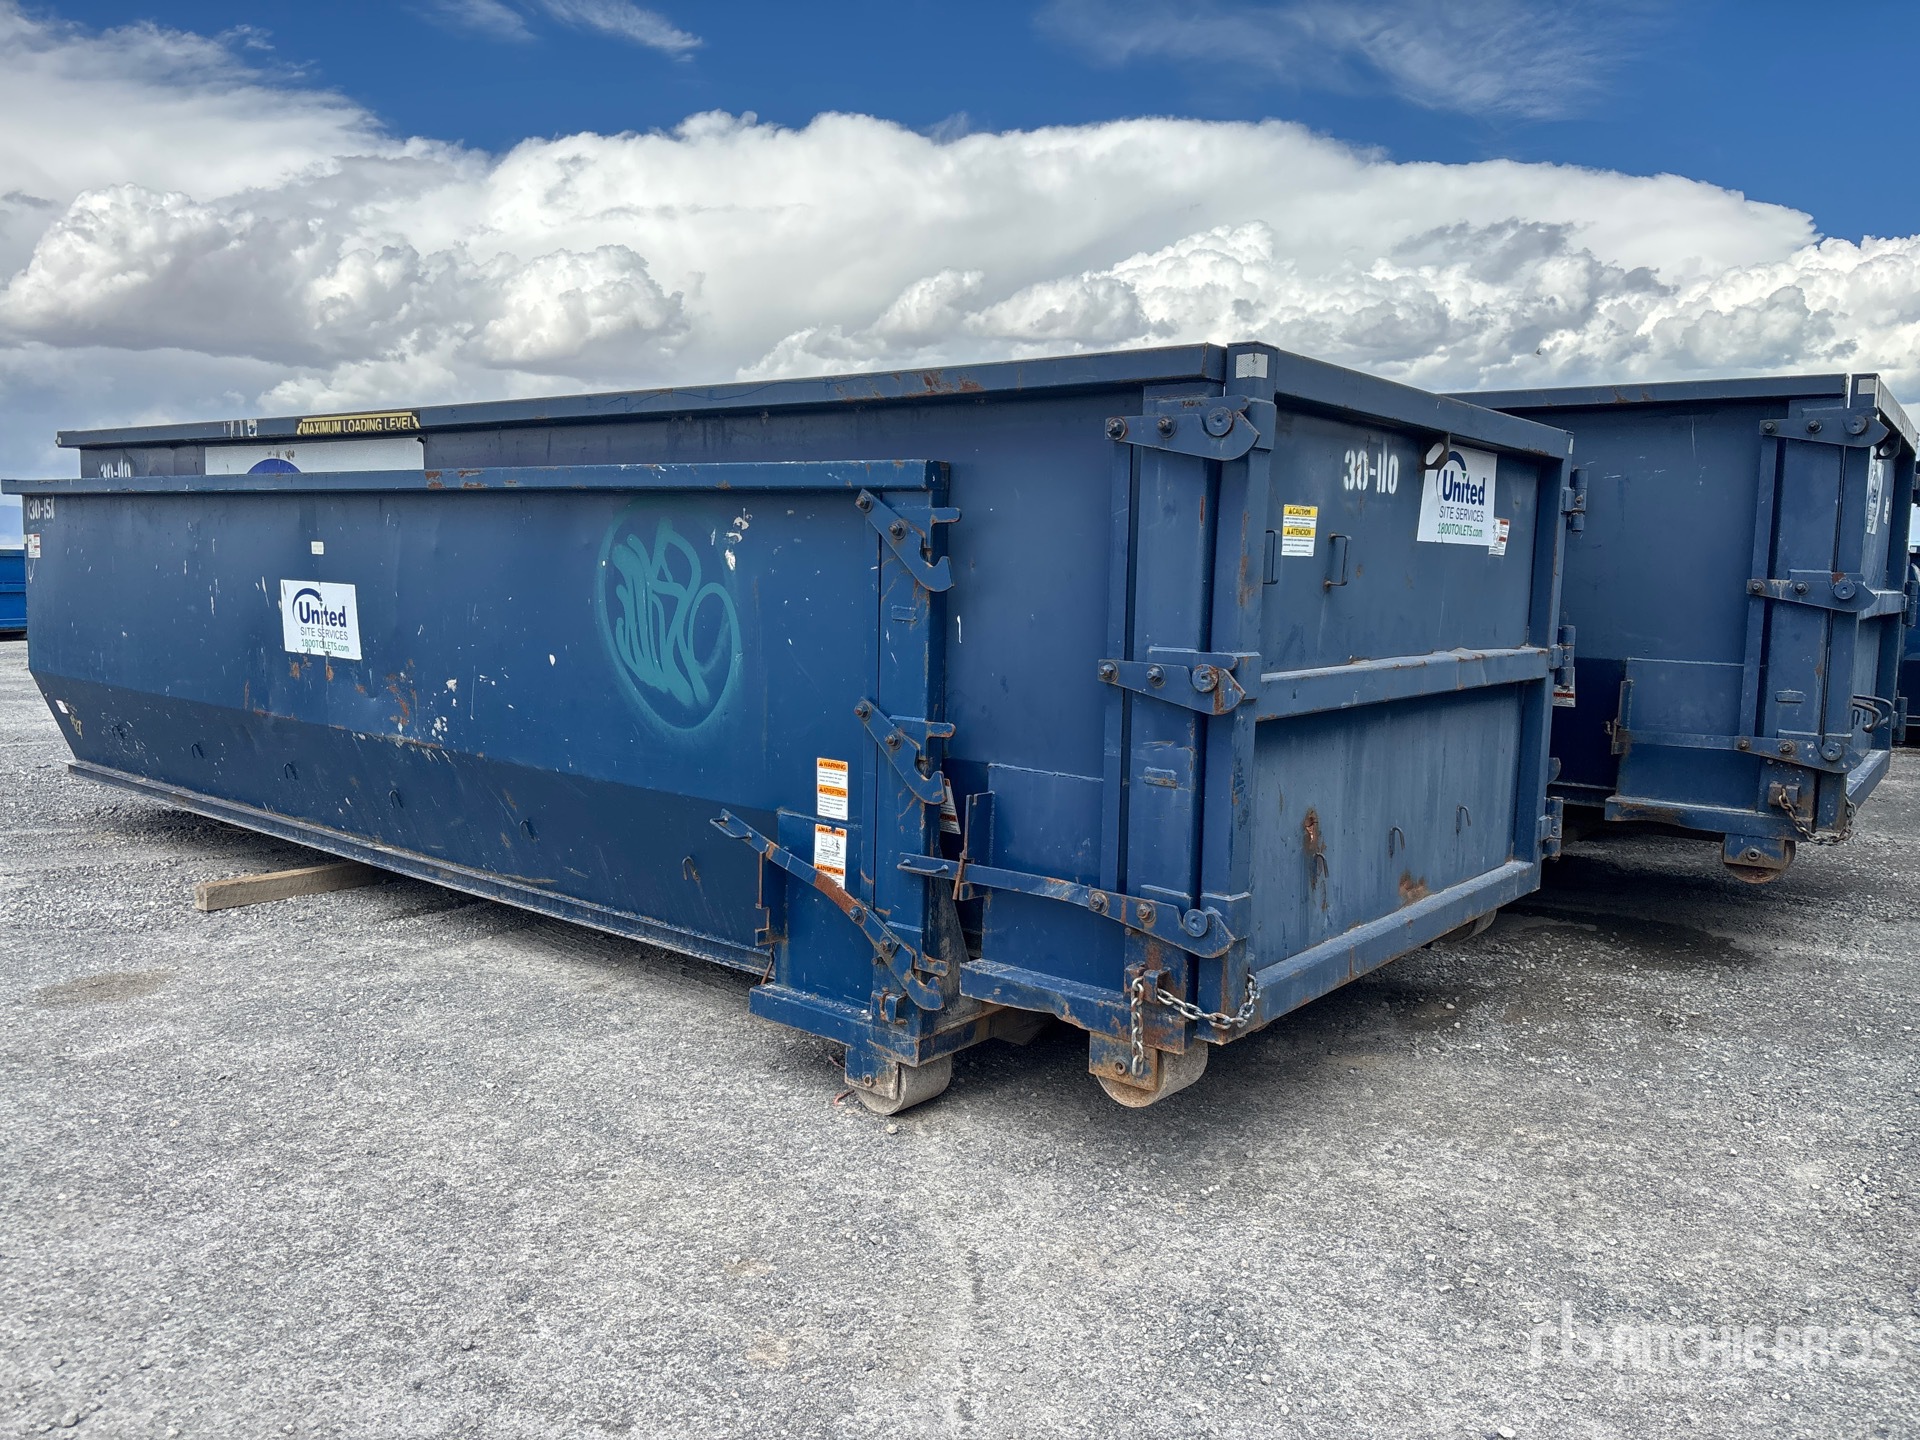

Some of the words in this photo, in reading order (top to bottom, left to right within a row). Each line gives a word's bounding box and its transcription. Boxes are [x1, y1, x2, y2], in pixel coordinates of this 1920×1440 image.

[302, 421, 341, 435] MAXIMUM
[343, 418, 382, 433] LOADING
[385, 416, 414, 431] LEVEL
[1442, 469, 1486, 506] United
[1292, 507, 1311, 516] CAUTION
[1439, 505, 1454, 519] SITE
[1455, 507, 1484, 523] SERVICES
[1437, 522, 1483, 538] 1800TOILETS.com
[298, 601, 347, 628] United
[300, 627, 316, 638] SITE
[317, 629, 349, 641] SERVICES
[301, 639, 350, 652] 1800TOILETS.com
[823, 761, 846, 771] WARNING
